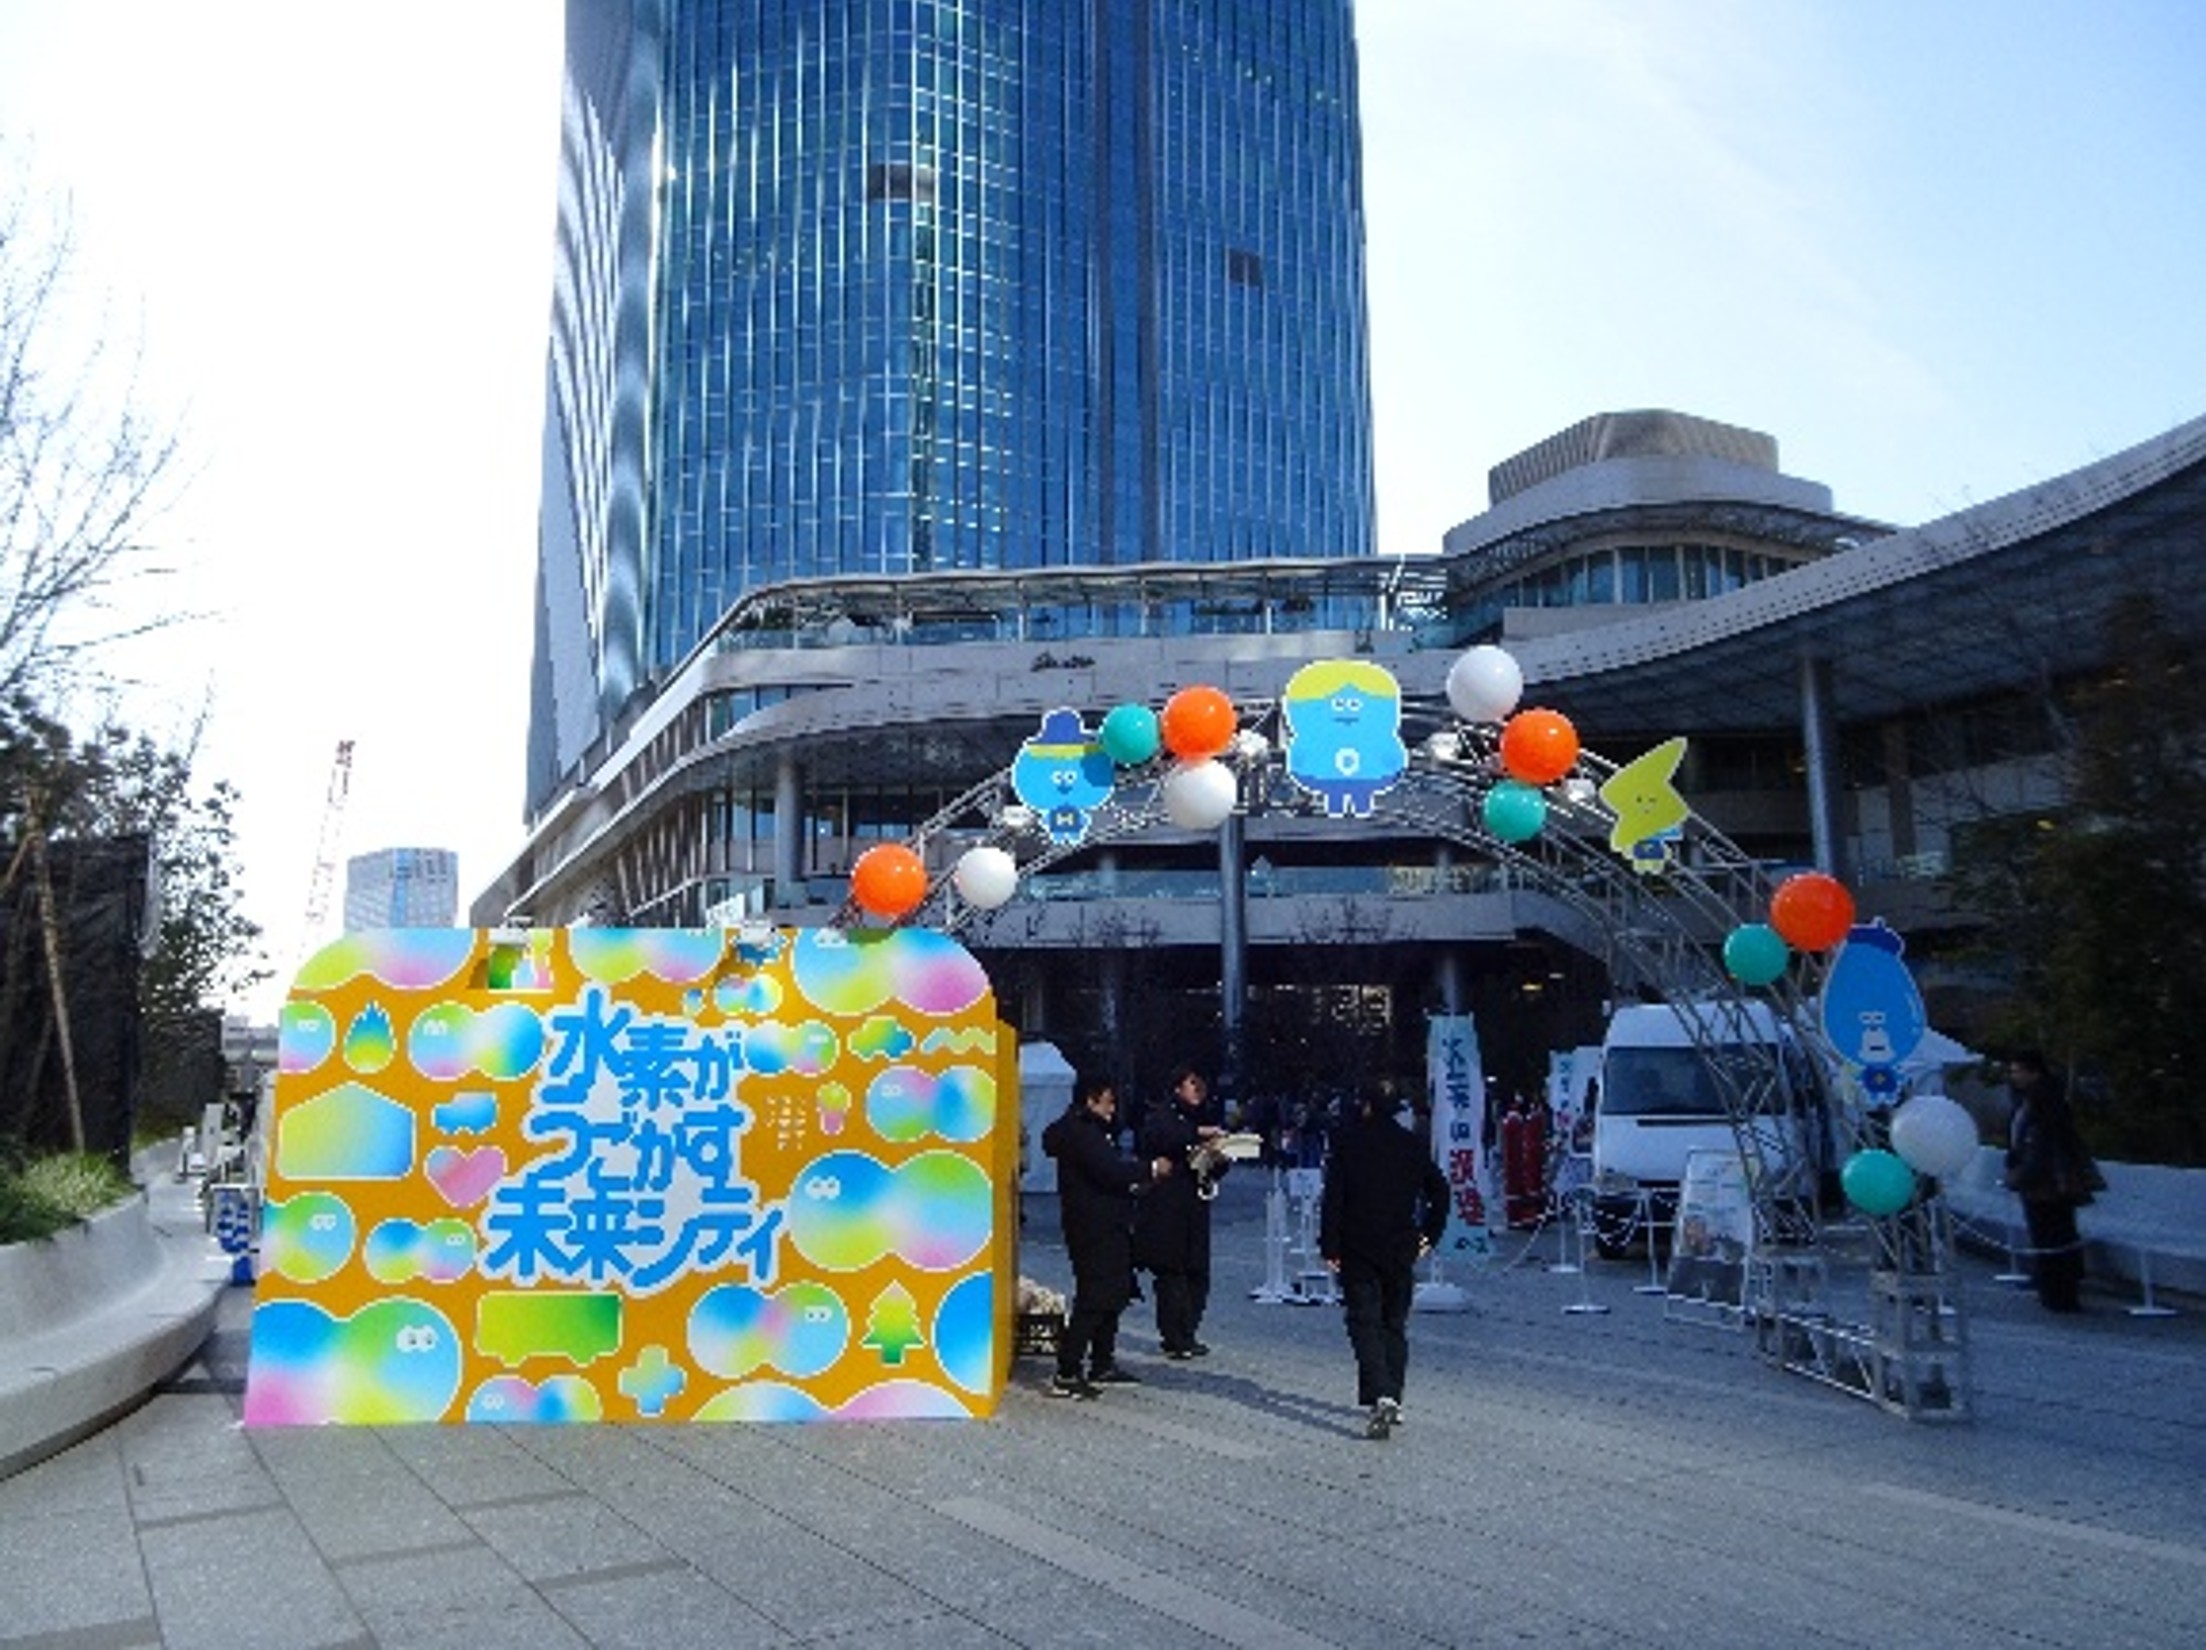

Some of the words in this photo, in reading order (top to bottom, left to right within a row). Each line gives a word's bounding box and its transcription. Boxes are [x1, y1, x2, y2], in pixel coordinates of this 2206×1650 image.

[541, 988, 745, 1111] 水素が
[484, 1180, 783, 1288] 未来シティ
